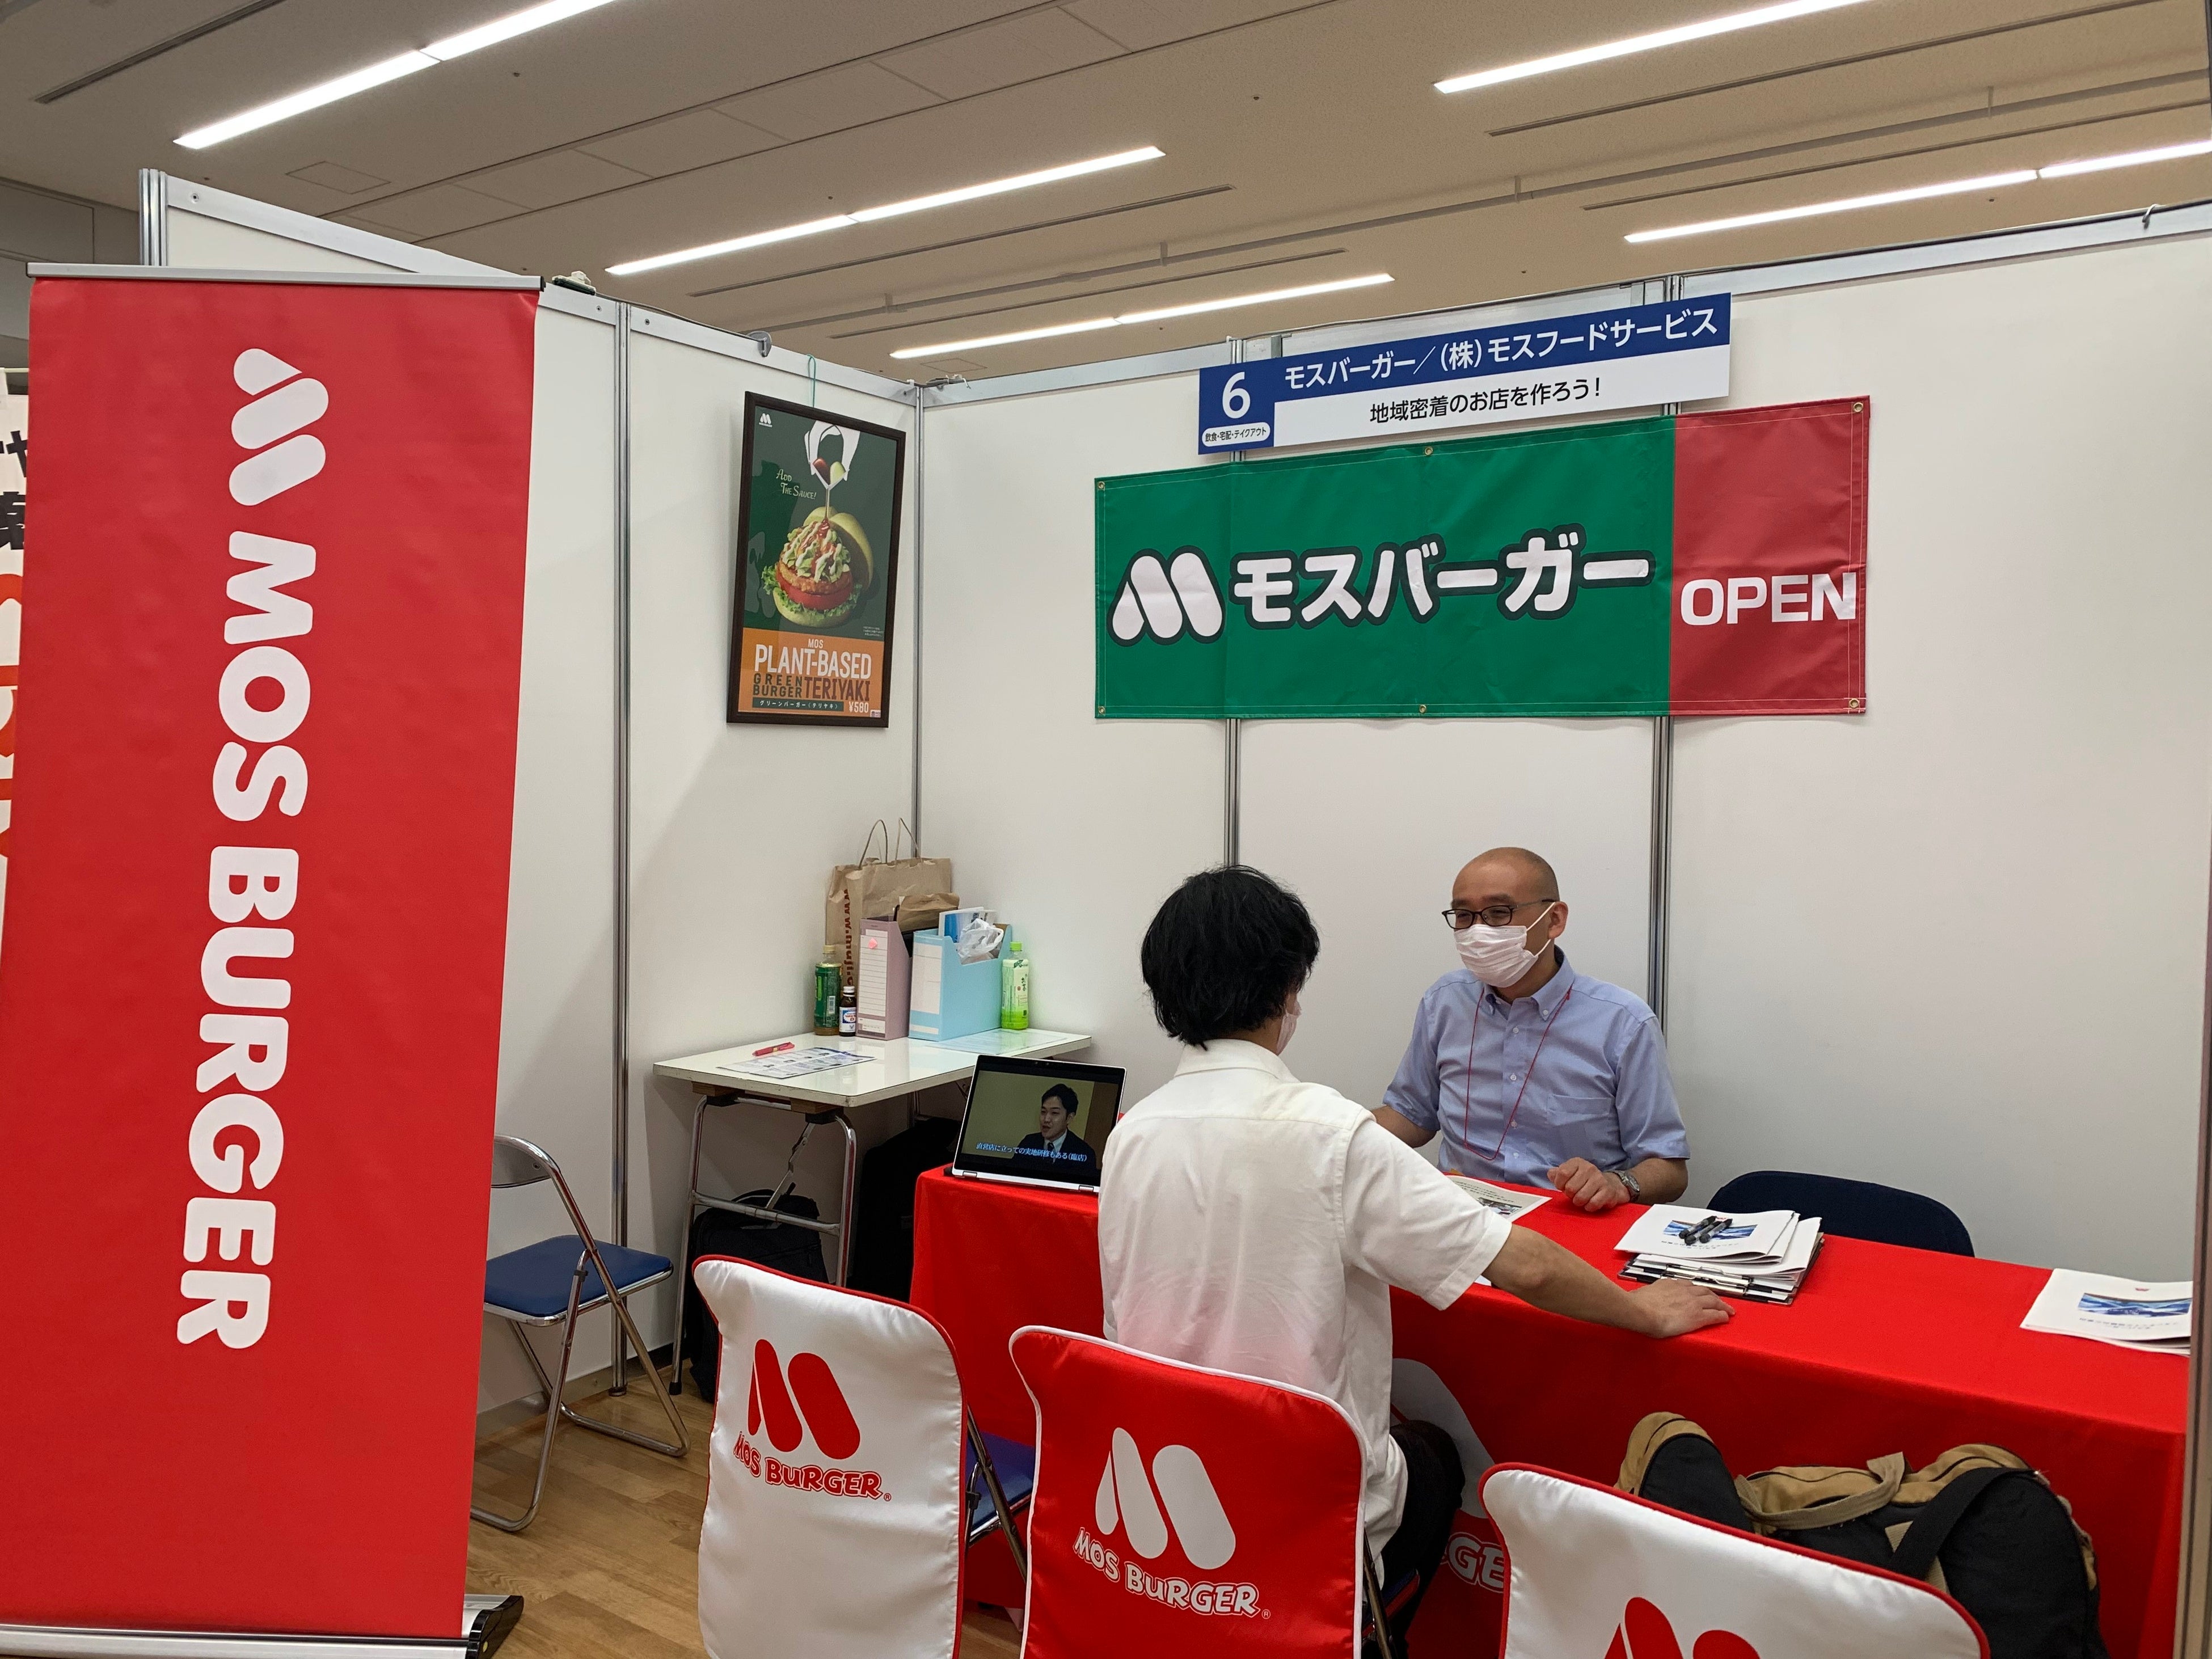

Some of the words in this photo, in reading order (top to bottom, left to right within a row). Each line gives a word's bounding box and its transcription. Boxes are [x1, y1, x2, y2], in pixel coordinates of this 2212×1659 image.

[1222, 372, 1251, 419] 6
[1370, 378, 1601, 423] 地域密着のお店を作ろう！
[1234, 531, 1650, 623] モスバーガー
[1679, 571, 1857, 626] OPEN
[754, 644, 872, 679] PLANT-BASED
[808, 639, 824, 648] MOS
[212, 530, 316, 822] MOS
[753, 673, 803, 686] GREEN
[753, 685, 803, 698] BURGER
[804, 677, 871, 702] TERIYAKI
[849, 701, 869, 713] ¥580
[176, 845, 299, 1349] BURGER
[733, 1431, 761, 1478] MOS
[765, 1457, 883, 1500] BURGER
[1073, 1526, 1120, 1582] MOS
[1125, 1561, 1261, 1618] BURGER
